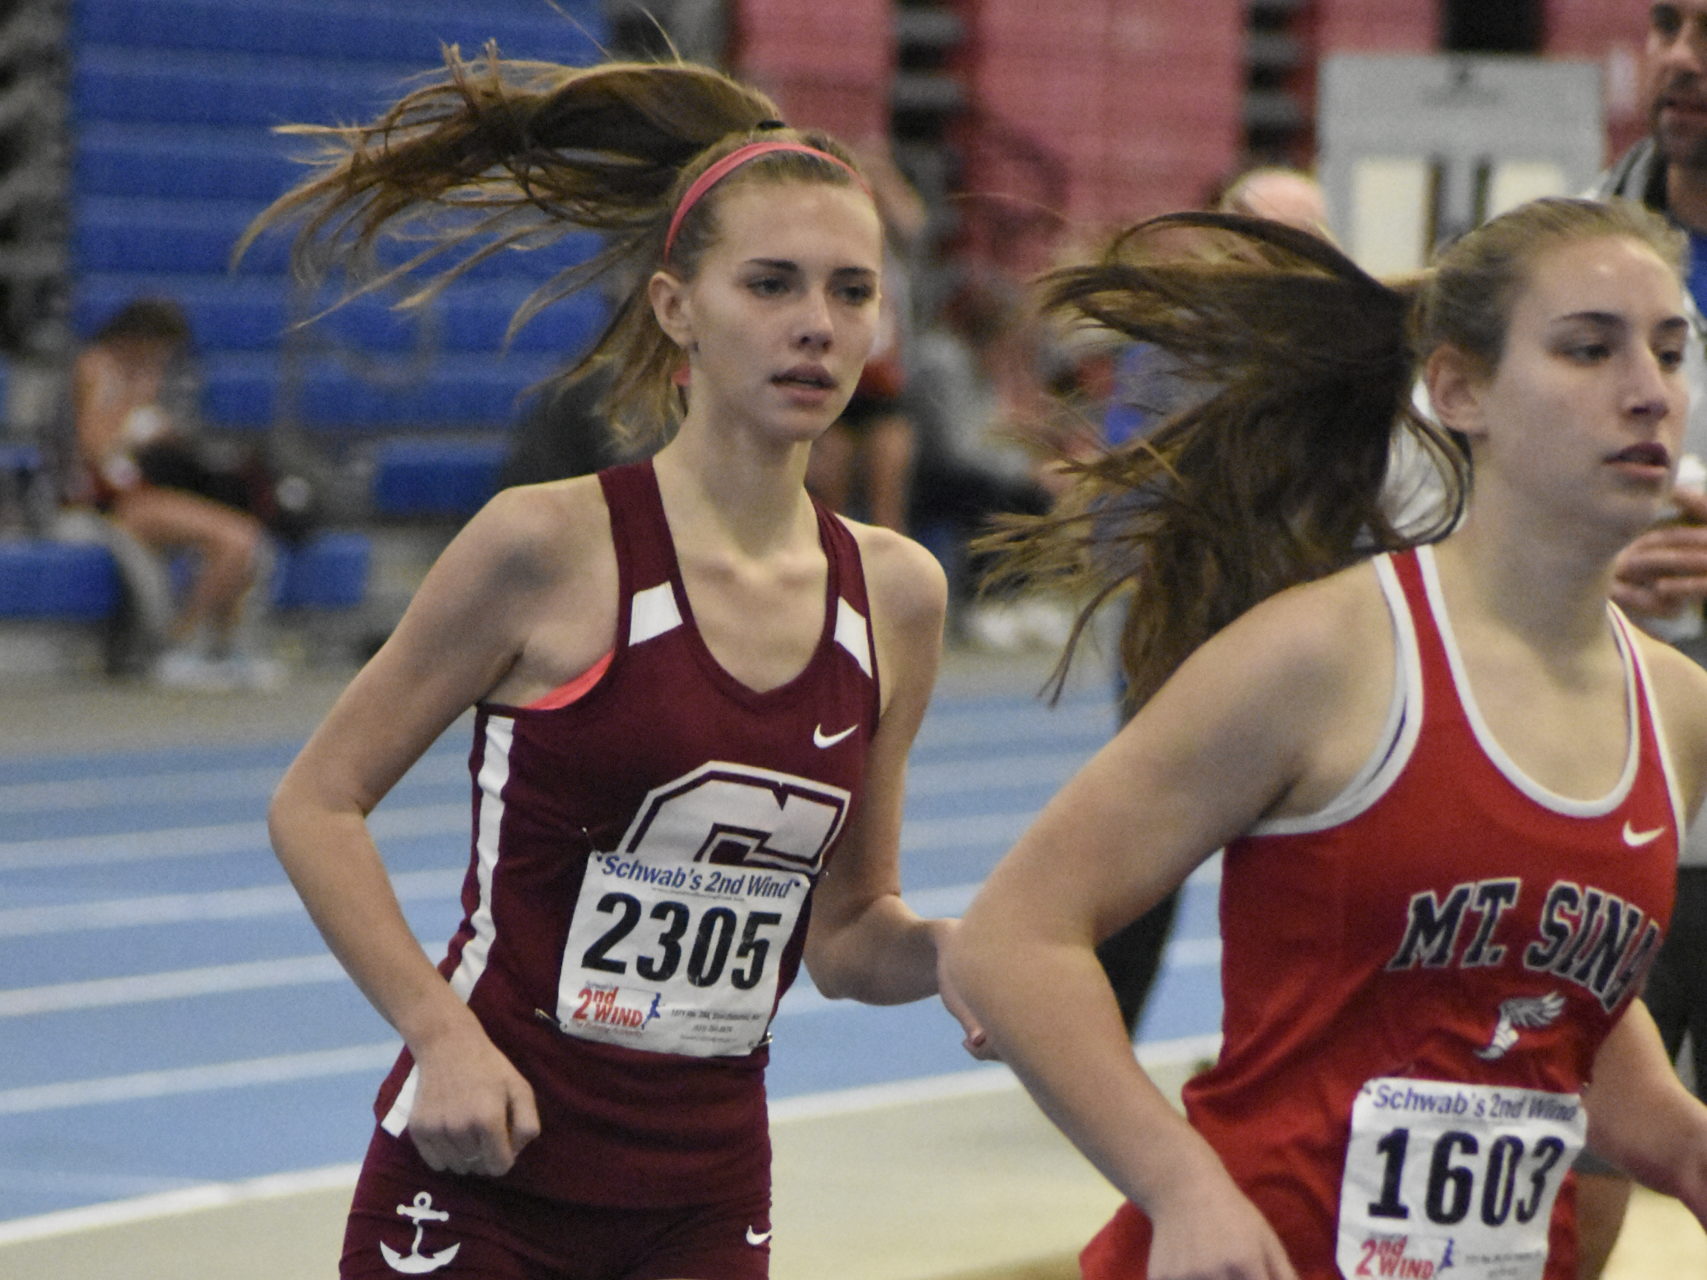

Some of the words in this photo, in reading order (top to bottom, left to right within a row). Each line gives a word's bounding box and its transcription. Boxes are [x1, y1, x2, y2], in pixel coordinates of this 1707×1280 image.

[602, 854, 704, 891] Schwab's
[704, 871, 746, 895] 2nd
[748, 874, 793, 899] Wind
[581, 892, 782, 990] 2305
[1386, 877, 1522, 973] MT.
[572, 986, 620, 1020] 2nd
[594, 1004, 643, 1028] WIND
[1373, 1083, 1485, 1118] Schwab's
[1489, 1093, 1525, 1119] 2nd
[1368, 1128, 1564, 1226] 1603
[1379, 1255, 1434, 1280] WIND
